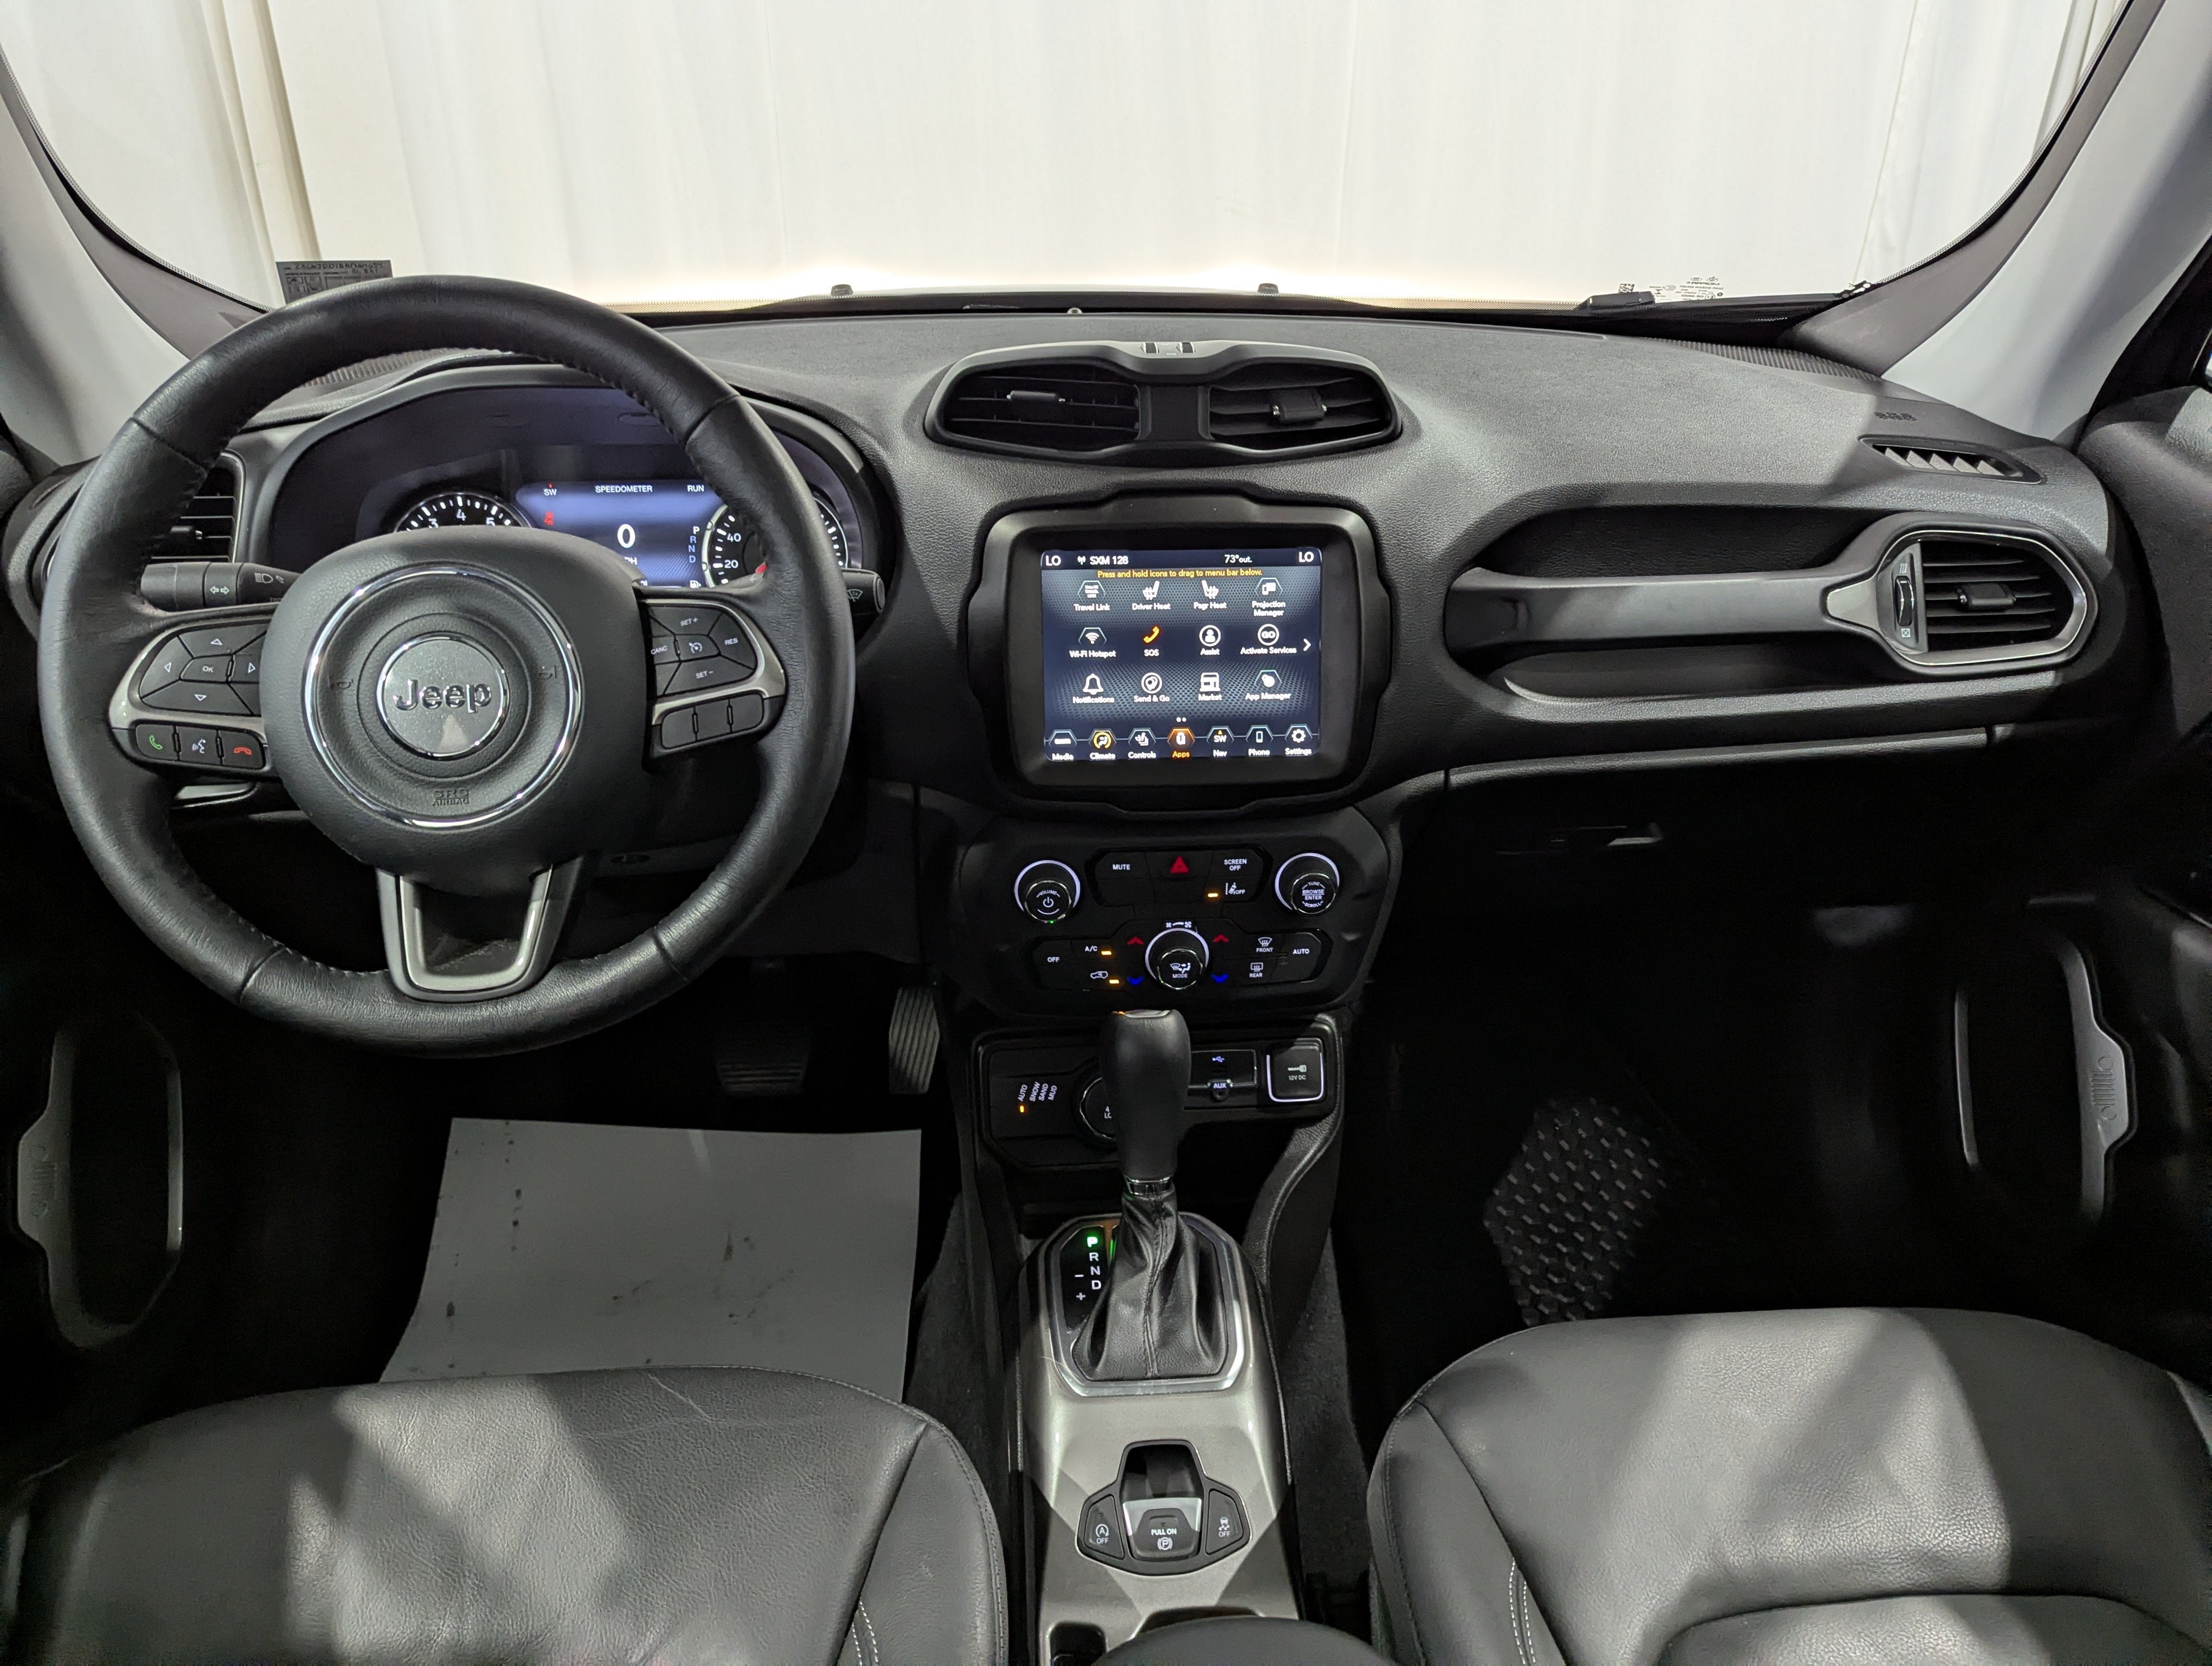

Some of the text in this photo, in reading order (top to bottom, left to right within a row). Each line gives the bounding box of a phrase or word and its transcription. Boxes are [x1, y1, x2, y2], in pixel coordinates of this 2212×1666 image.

[595, 485, 653, 493] SPEEDOMETER
[456, 509, 466, 521] 4
[486, 517, 496, 527] 5
[693, 526, 700, 535] P
[617, 524, 635, 548] 0
[726, 533, 742, 542] 40
[688, 544, 696, 553] N
[1045, 555, 1062, 566] LO
[1090, 555, 1129, 565] SXM 128
[1298, 552, 1314, 562] LO
[724, 560, 738, 568] 20
[1179, 569, 1194, 578] drag
[1073, 603, 1095, 611] Travel
[1252, 601, 1286, 609] Projection
[651, 645, 668, 655] CANC
[1069, 650, 1116, 658] Wi-Fi Hotspot
[202, 665, 214, 674] OK
[394, 679, 492, 714] Jeep
[1261, 693, 1291, 701] Manager
[1128, 751, 1156, 759] Controls
[1285, 747, 1312, 756] Settings
[1018, 1085, 1028, 1102] AUTO
[1029, 1081, 1040, 1102] SNOW
[1038, 1084, 1049, 1101] SAND
[1047, 1085, 1057, 1101] MUD
[1086, 1236, 1098, 1247] P
[1089, 1252, 1099, 1261] R
[1091, 1266, 1101, 1276] N
[1091, 1280, 1102, 1290] D
